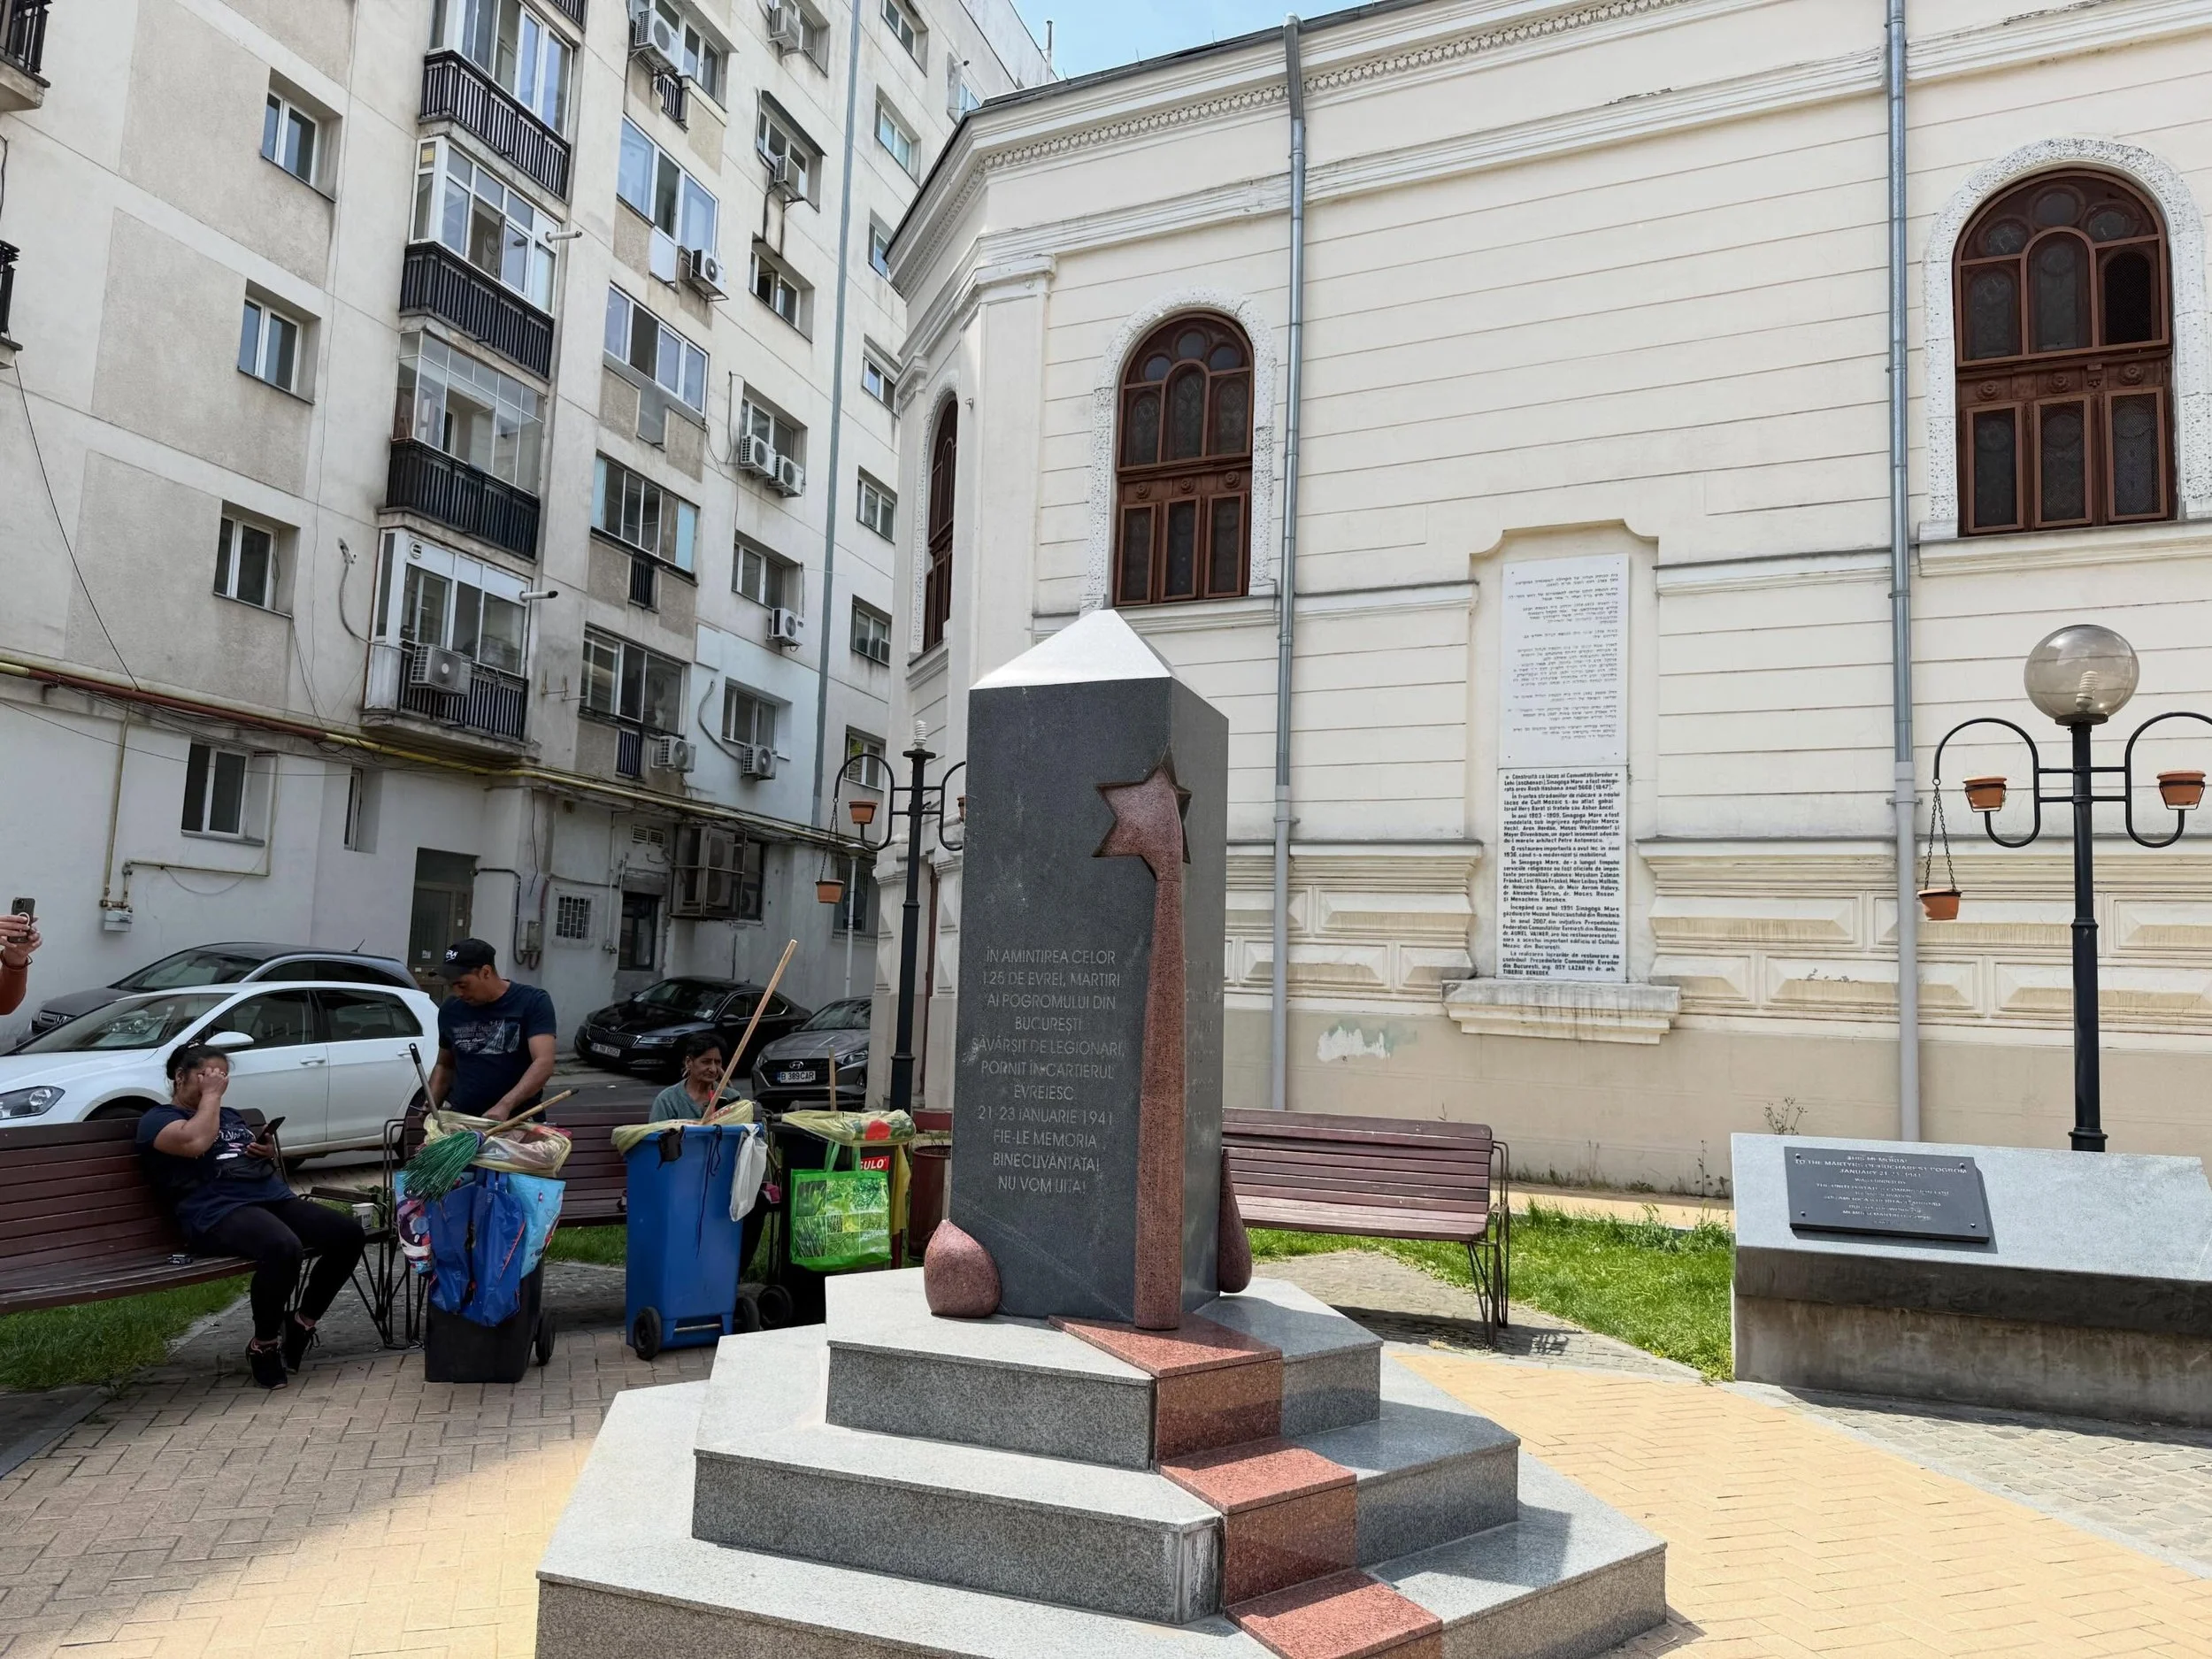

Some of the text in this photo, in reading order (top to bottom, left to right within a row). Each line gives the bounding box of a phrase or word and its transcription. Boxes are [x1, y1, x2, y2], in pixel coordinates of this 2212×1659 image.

[1002, 949, 1068, 964] AMINTIREA
[1071, 950, 1115, 964] CELOR
[1008, 972, 1025, 985] DE
[1028, 972, 1066, 987] EVREI,
[1071, 973, 1120, 987] MARTIRI
[987, 994, 1115, 1009] AI POGROMULUI DIN
[1030, 1041, 1047, 1053] DE
[981, 1061, 1026, 1076] PORNIT
[1046, 1064, 1115, 1079] CARTIERUL
[1014, 1085, 1073, 1100] EVREIESC
[1019, 1108, 1078, 1124] IANUARIE
[1082, 1110, 1112, 1125] 1941
[1033, 1130, 1097, 1148] MEMORIA
[998, 1175, 1016, 1190] NU
[1019, 1177, 1052, 1193] VOM
